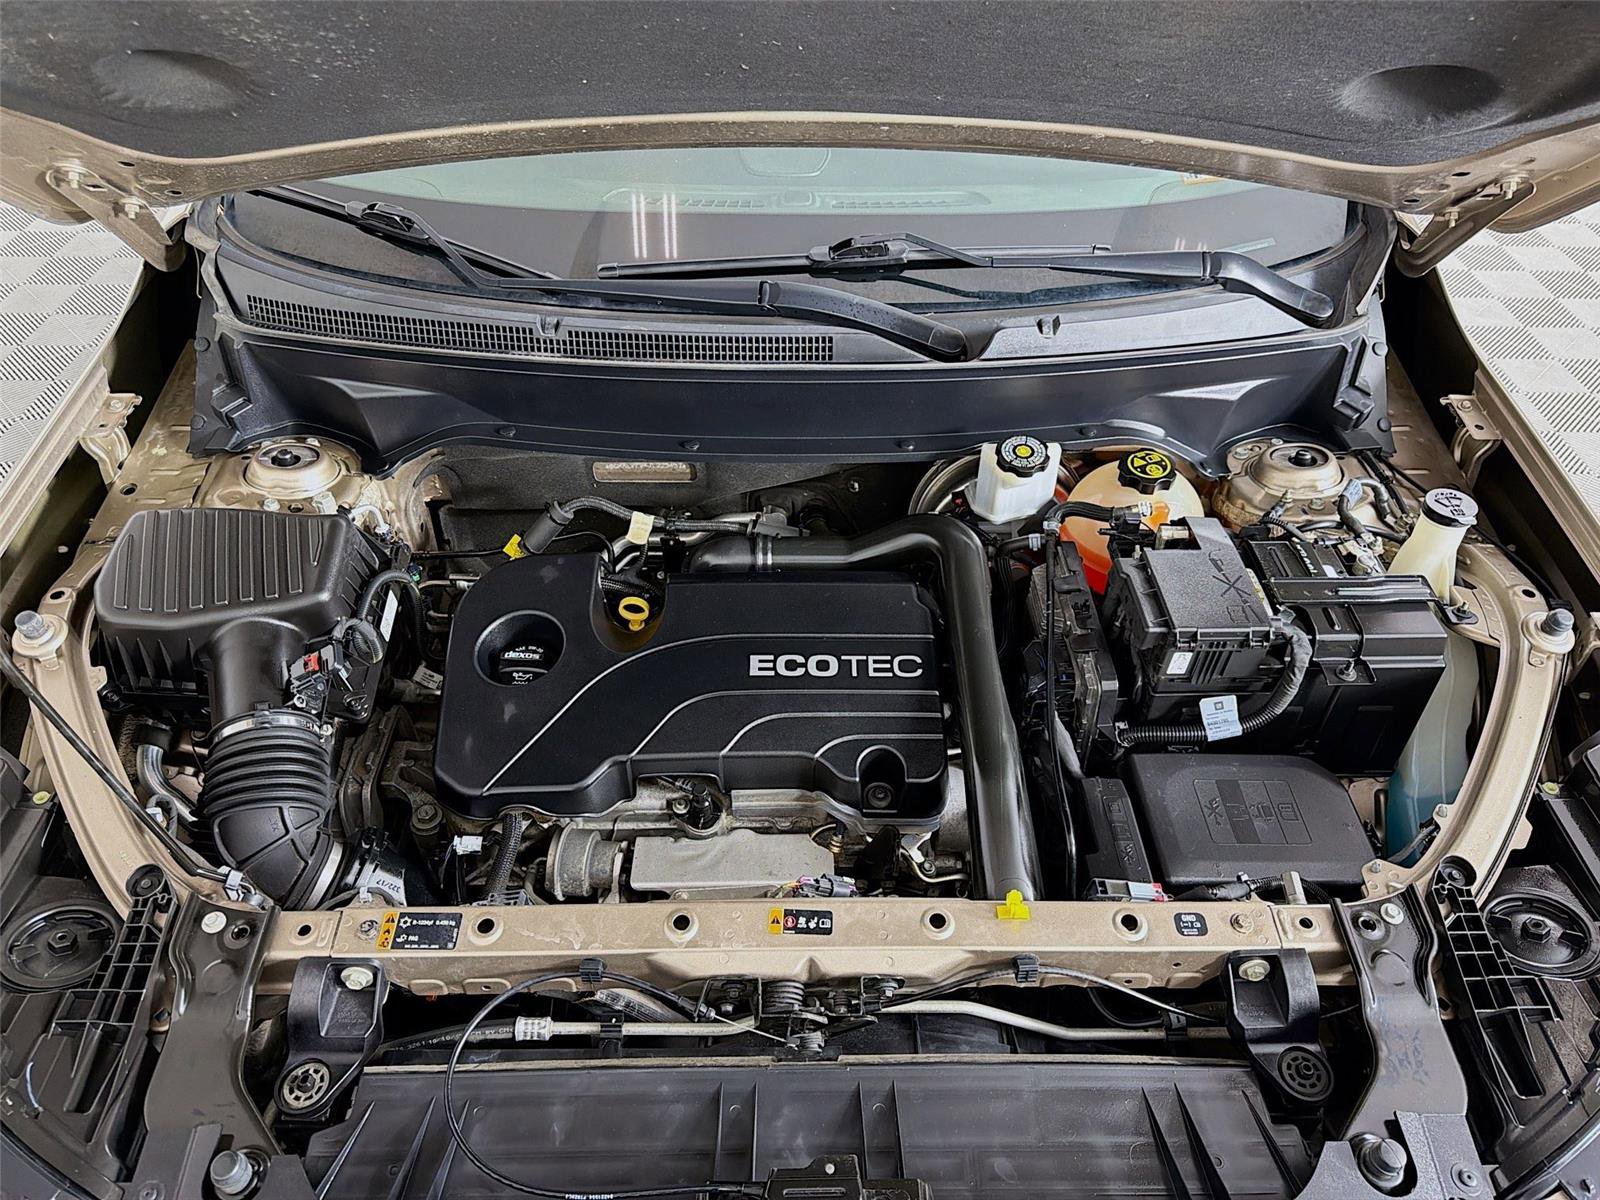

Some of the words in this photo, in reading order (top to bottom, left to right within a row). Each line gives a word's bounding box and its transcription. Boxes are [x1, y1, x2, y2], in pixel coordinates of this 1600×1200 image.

[504, 651, 541, 660] dexos
[749, 654, 923, 678] ECOTEC
[376, 879, 401, 894] 322/17
